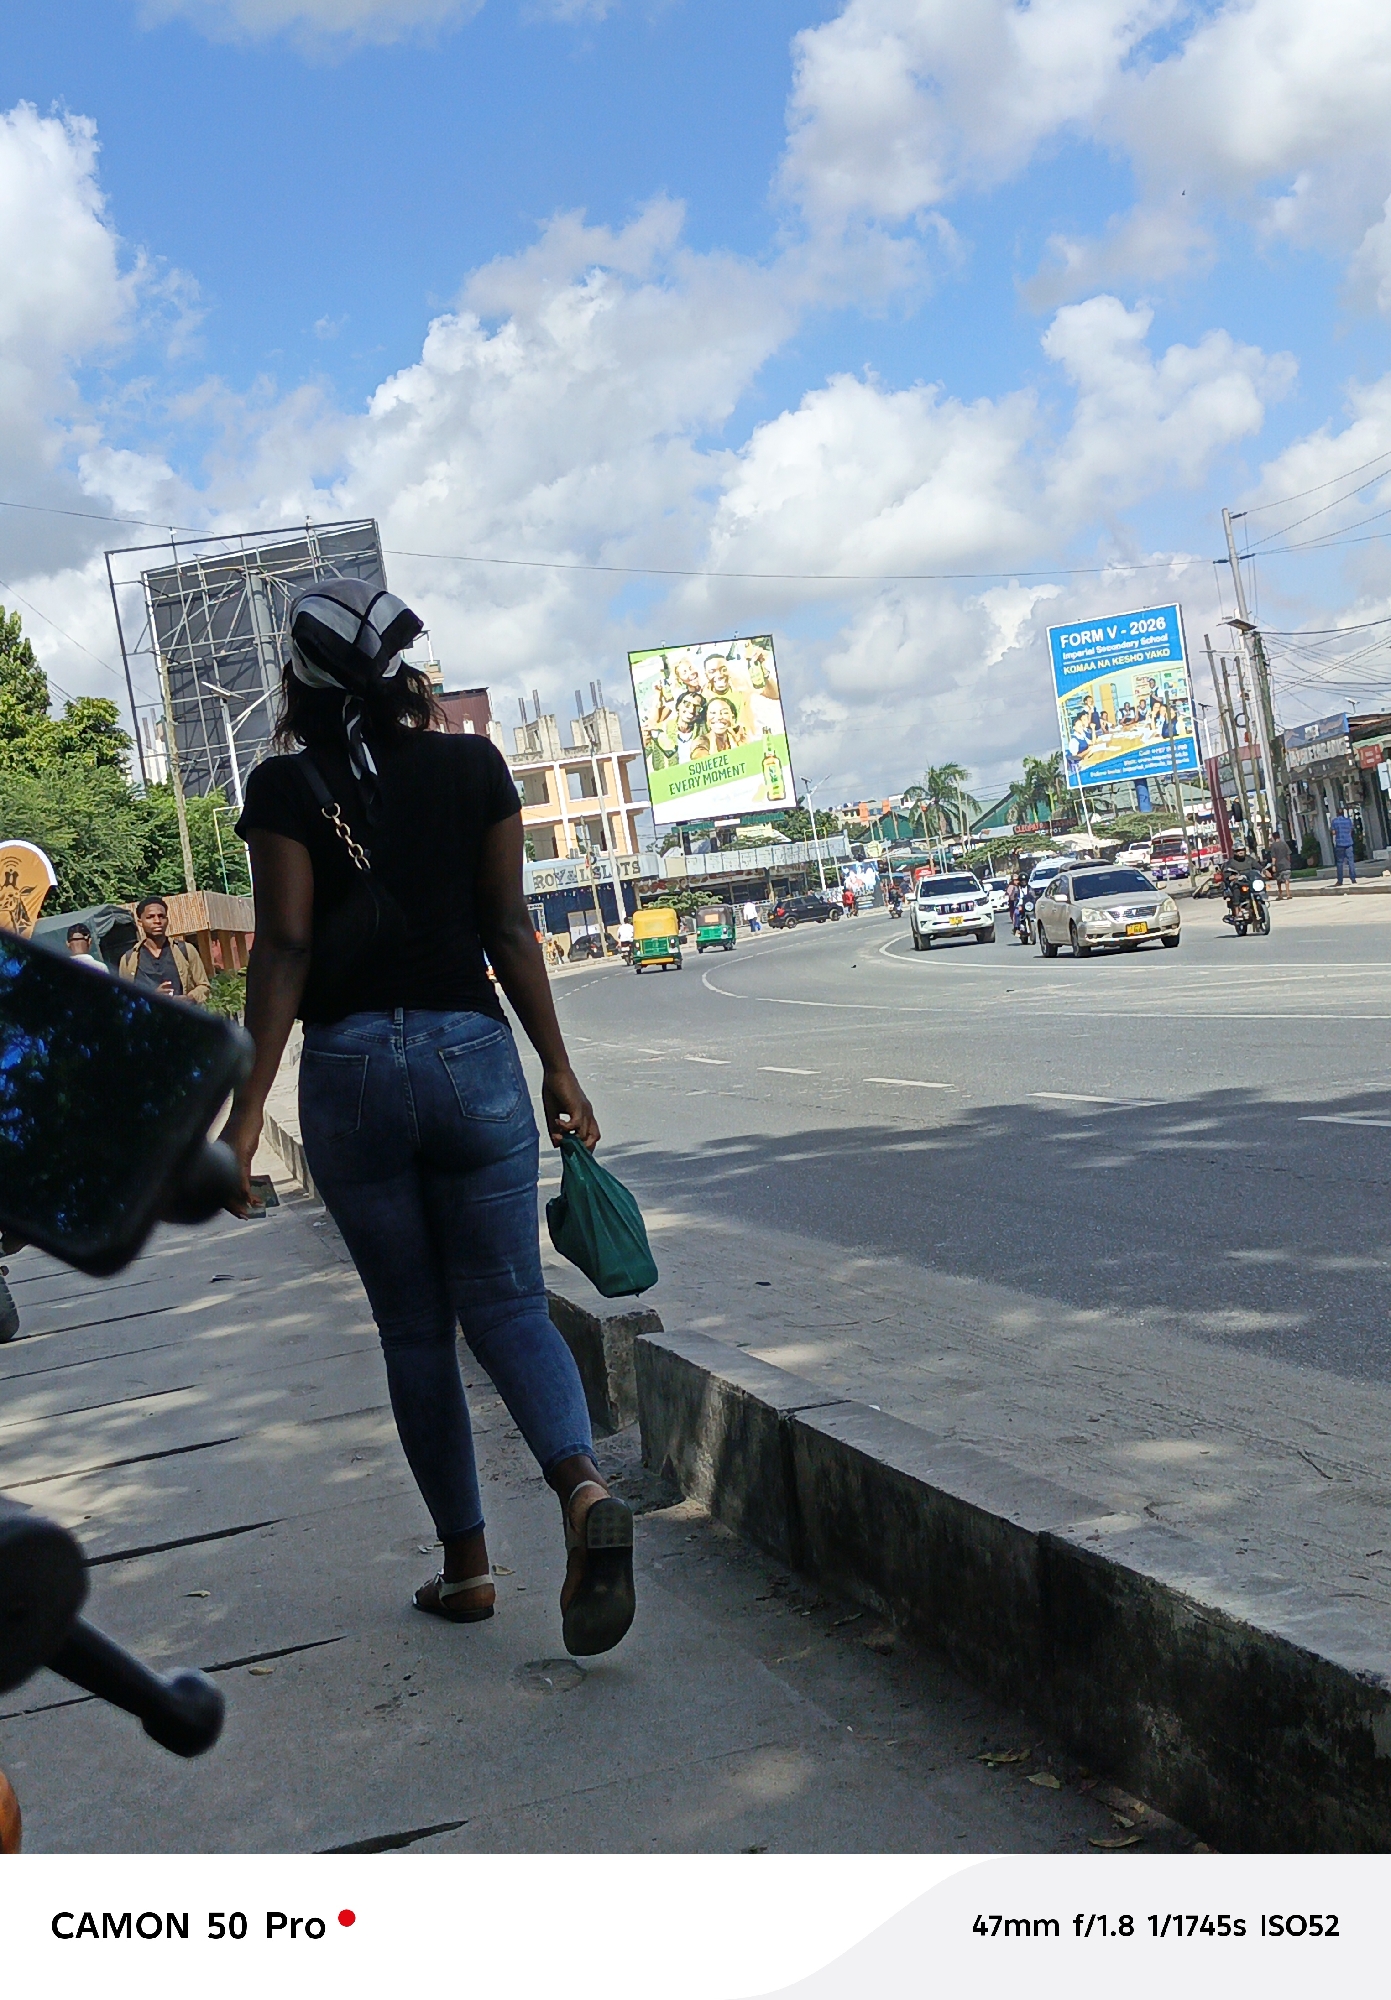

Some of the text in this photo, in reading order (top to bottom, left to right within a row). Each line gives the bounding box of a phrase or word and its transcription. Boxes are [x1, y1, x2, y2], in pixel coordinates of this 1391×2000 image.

[1060, 629, 1104, 649] FORM
[1106, 625, 1118, 639] V
[1129, 617, 1166, 636] 2026
[1062, 633, 1169, 660] Imperial Secondary School
[1063, 648, 1171, 675] KOMAA NA KESHO YAKO
[688, 754, 729, 776] SQUEEZE
[668, 775, 701, 795] EVERY
[703, 763, 746, 786] MOMENT
[533, 868, 591, 890] ROYAL
